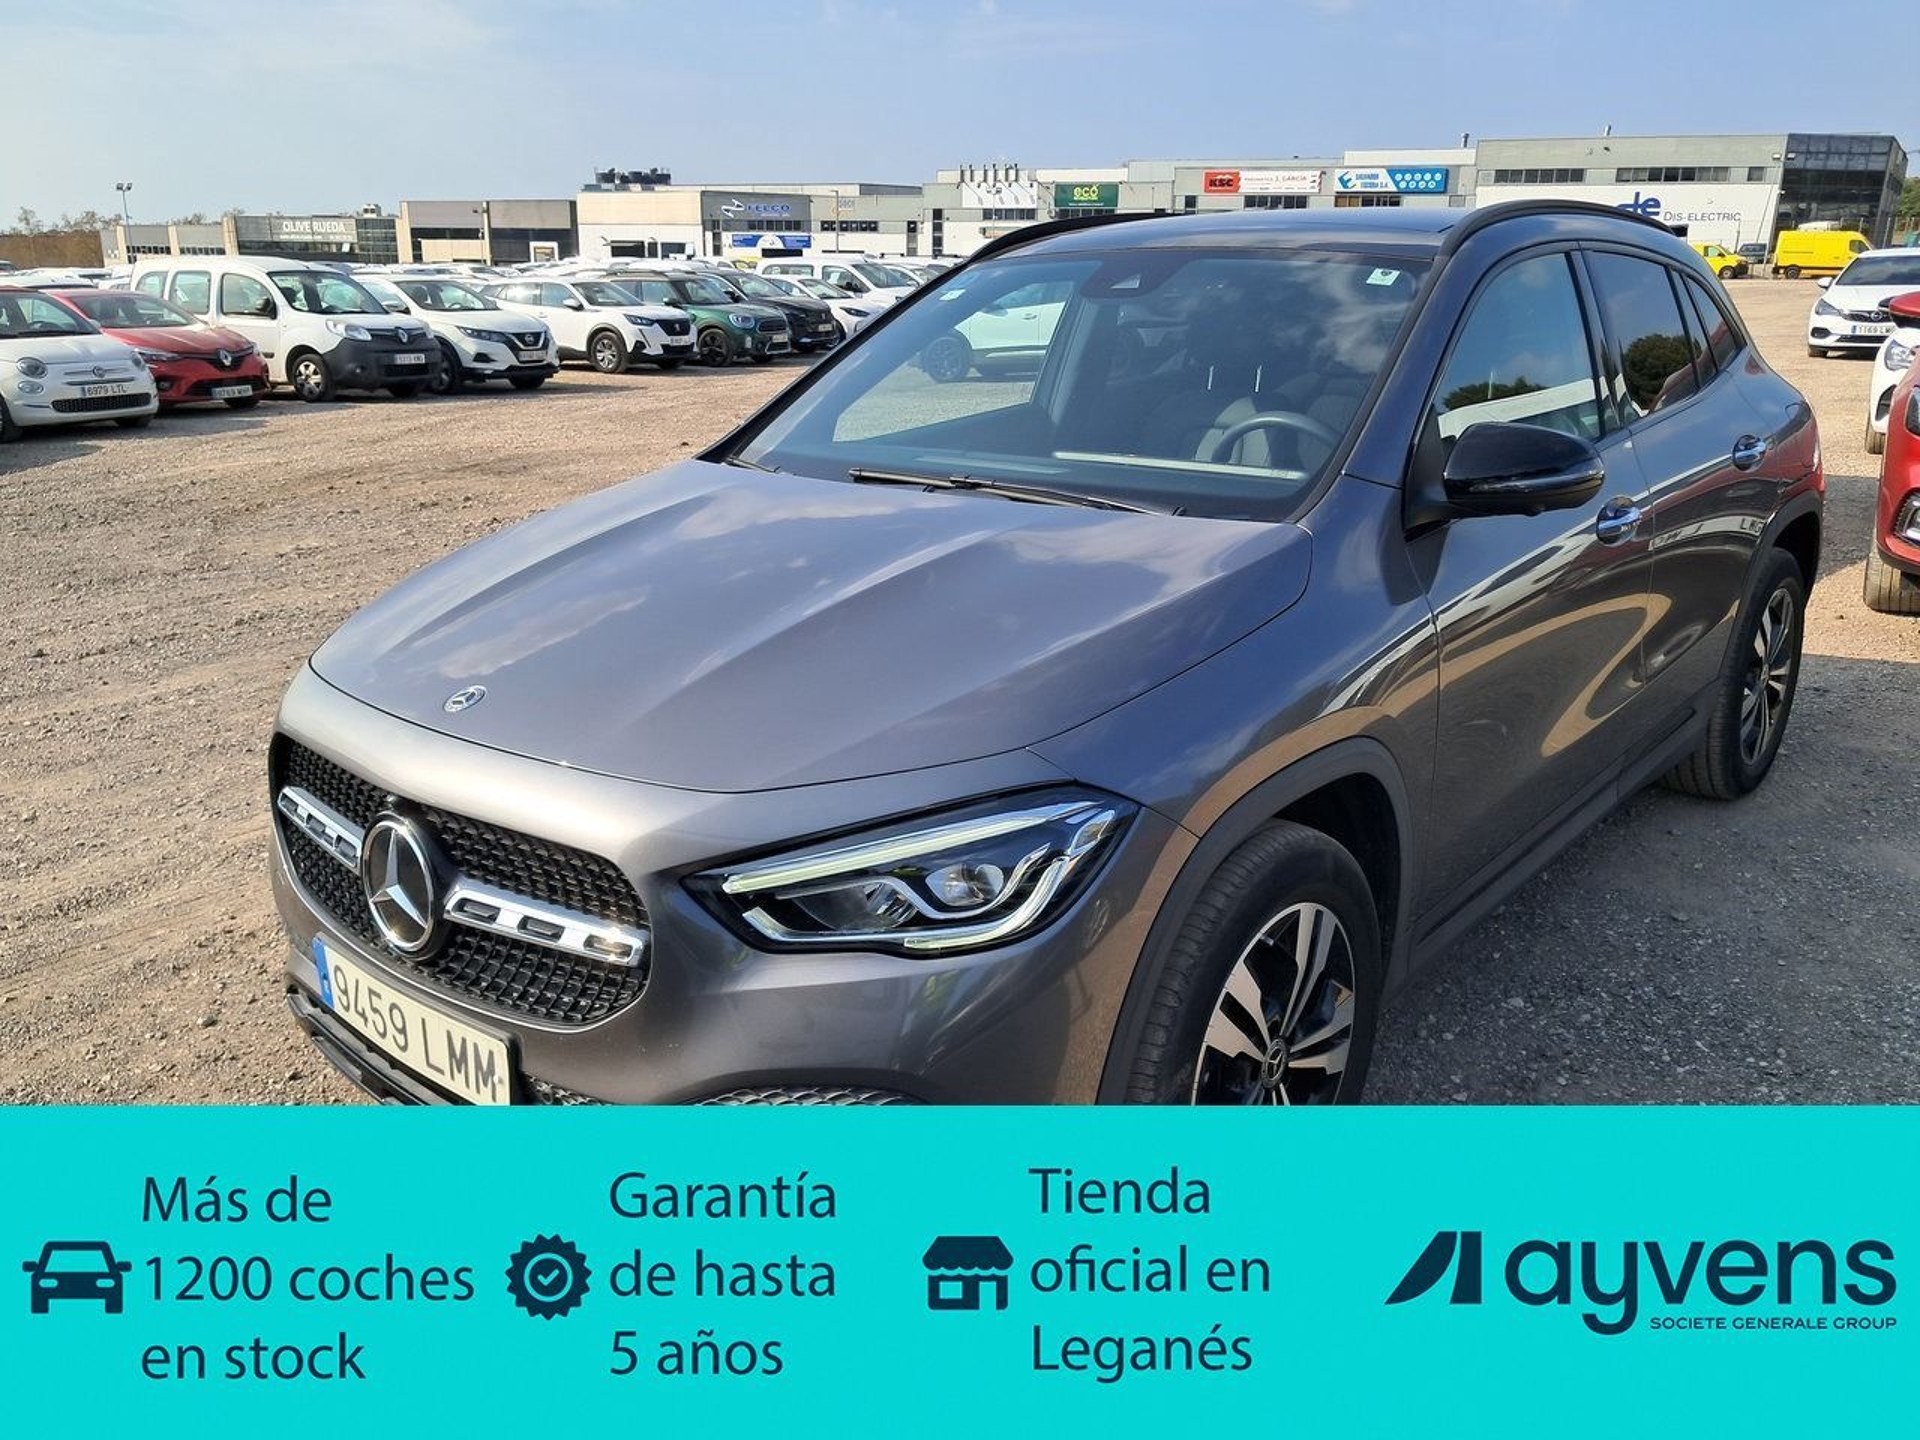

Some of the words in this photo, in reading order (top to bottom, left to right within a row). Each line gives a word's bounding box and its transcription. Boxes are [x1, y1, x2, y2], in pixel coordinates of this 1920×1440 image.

[1208, 178, 1234, 187] KSC
[283, 221, 311, 232] OLIVE
[313, 221, 346, 232] RUEDA
[334, 964, 409, 1053] 9459
[421, 1017, 498, 1103] LMM
